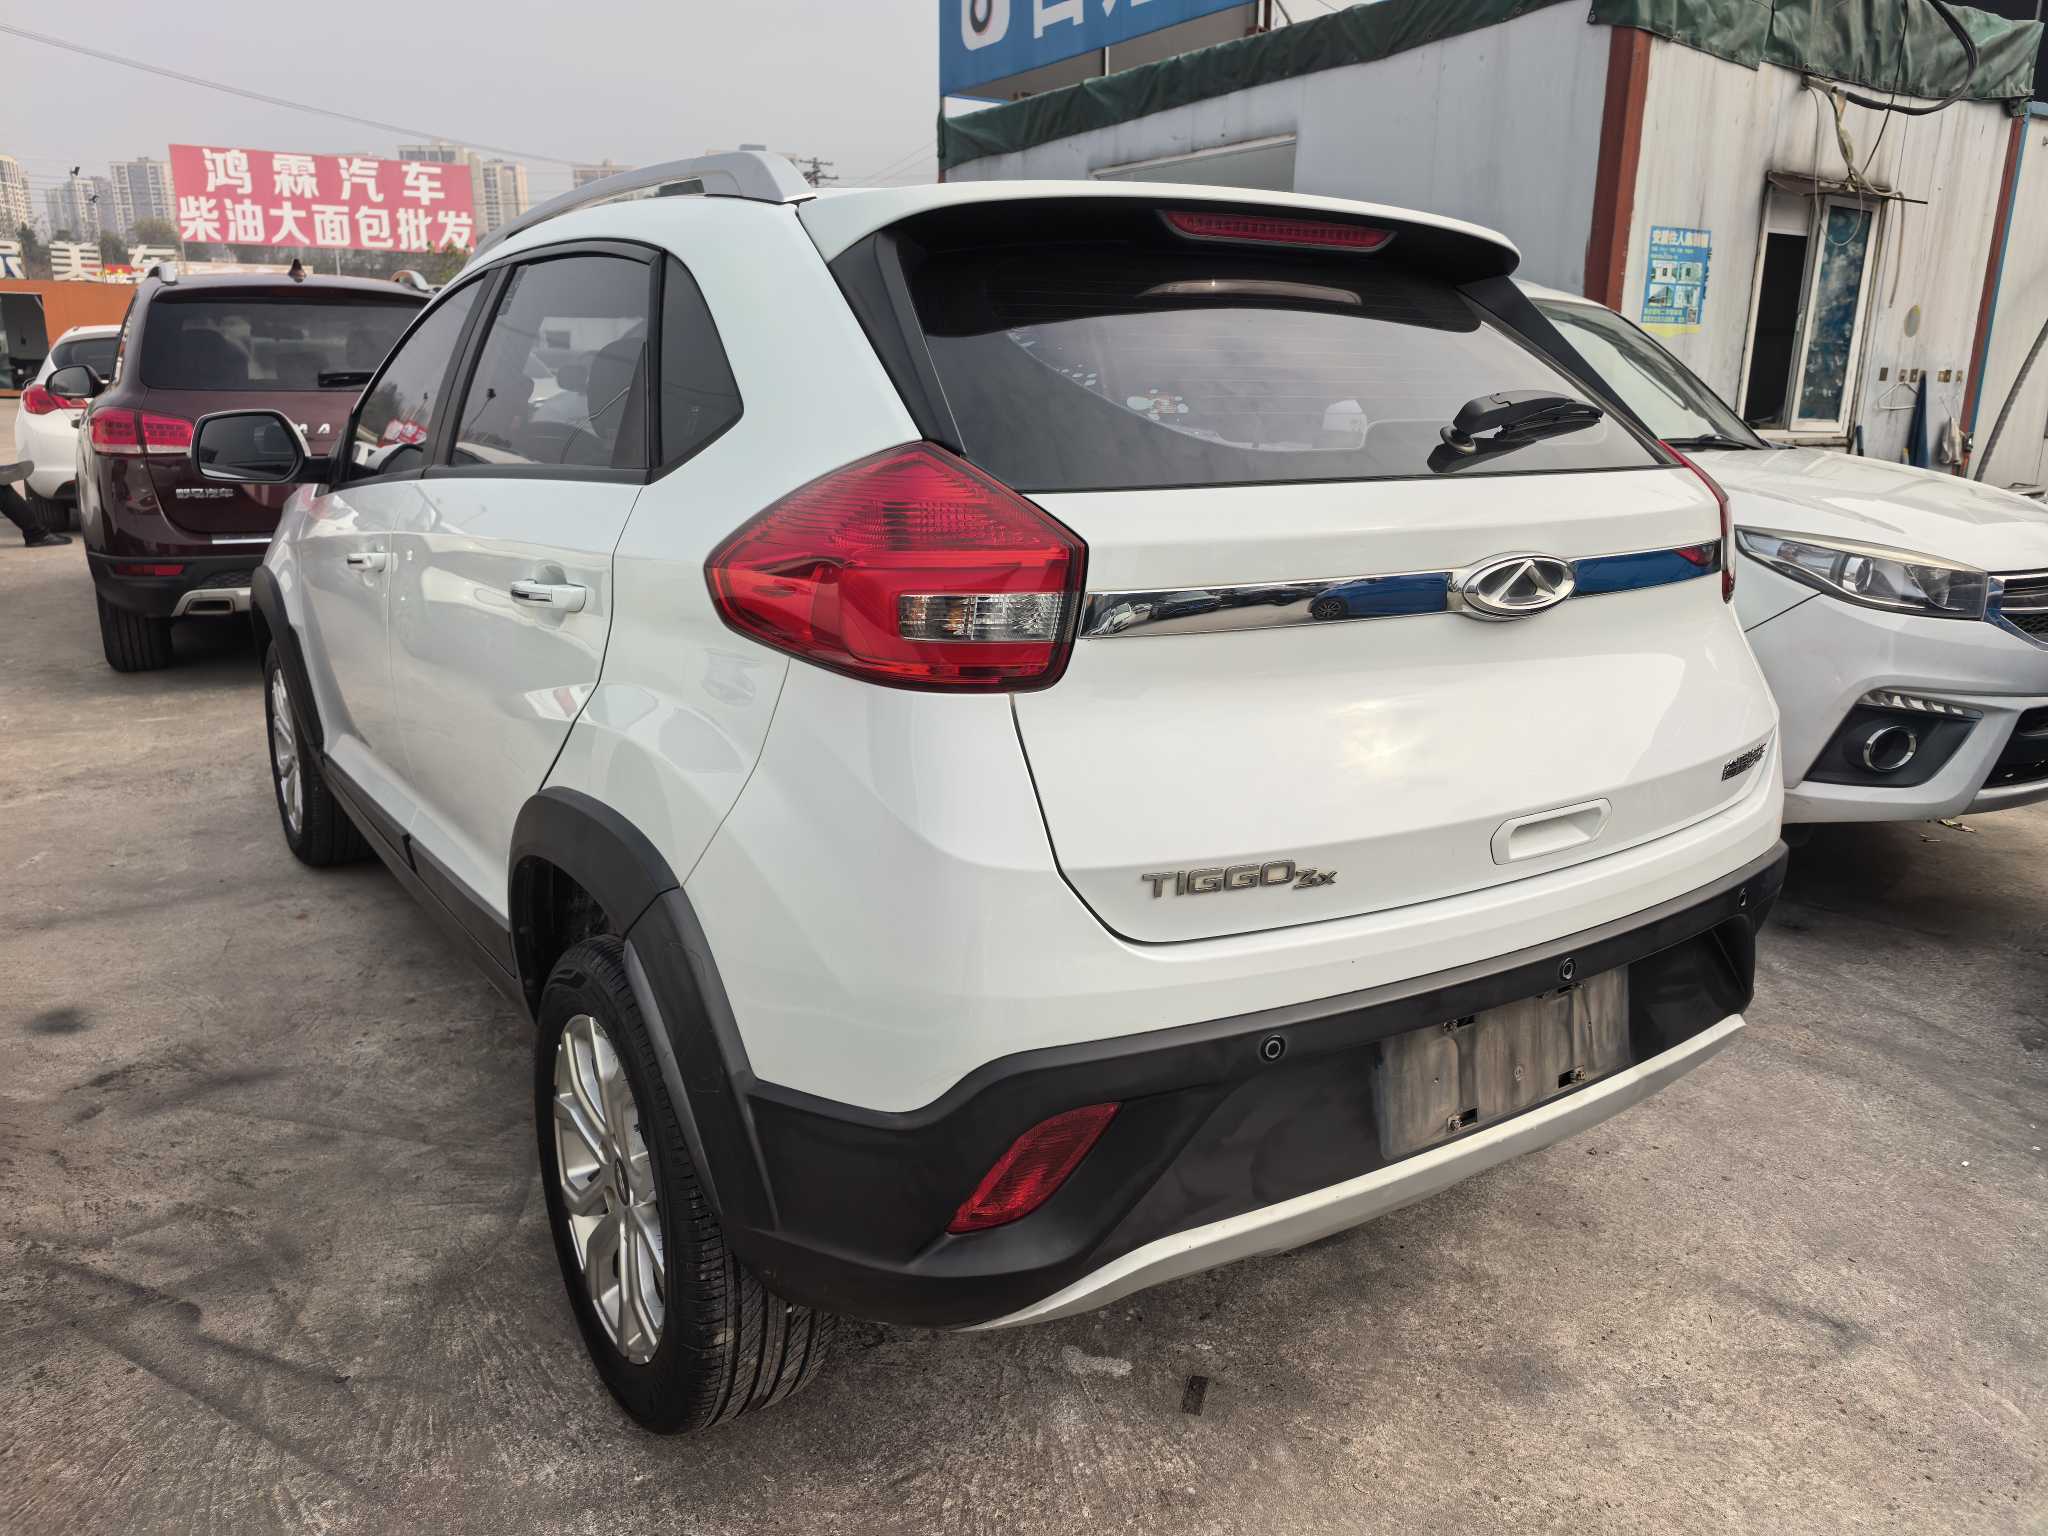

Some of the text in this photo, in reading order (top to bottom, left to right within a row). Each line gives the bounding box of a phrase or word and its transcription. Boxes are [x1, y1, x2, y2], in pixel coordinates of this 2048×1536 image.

[203, 148, 446, 206] 鸿霖汽车
[179, 196, 476, 253] 柴油大面包批发
